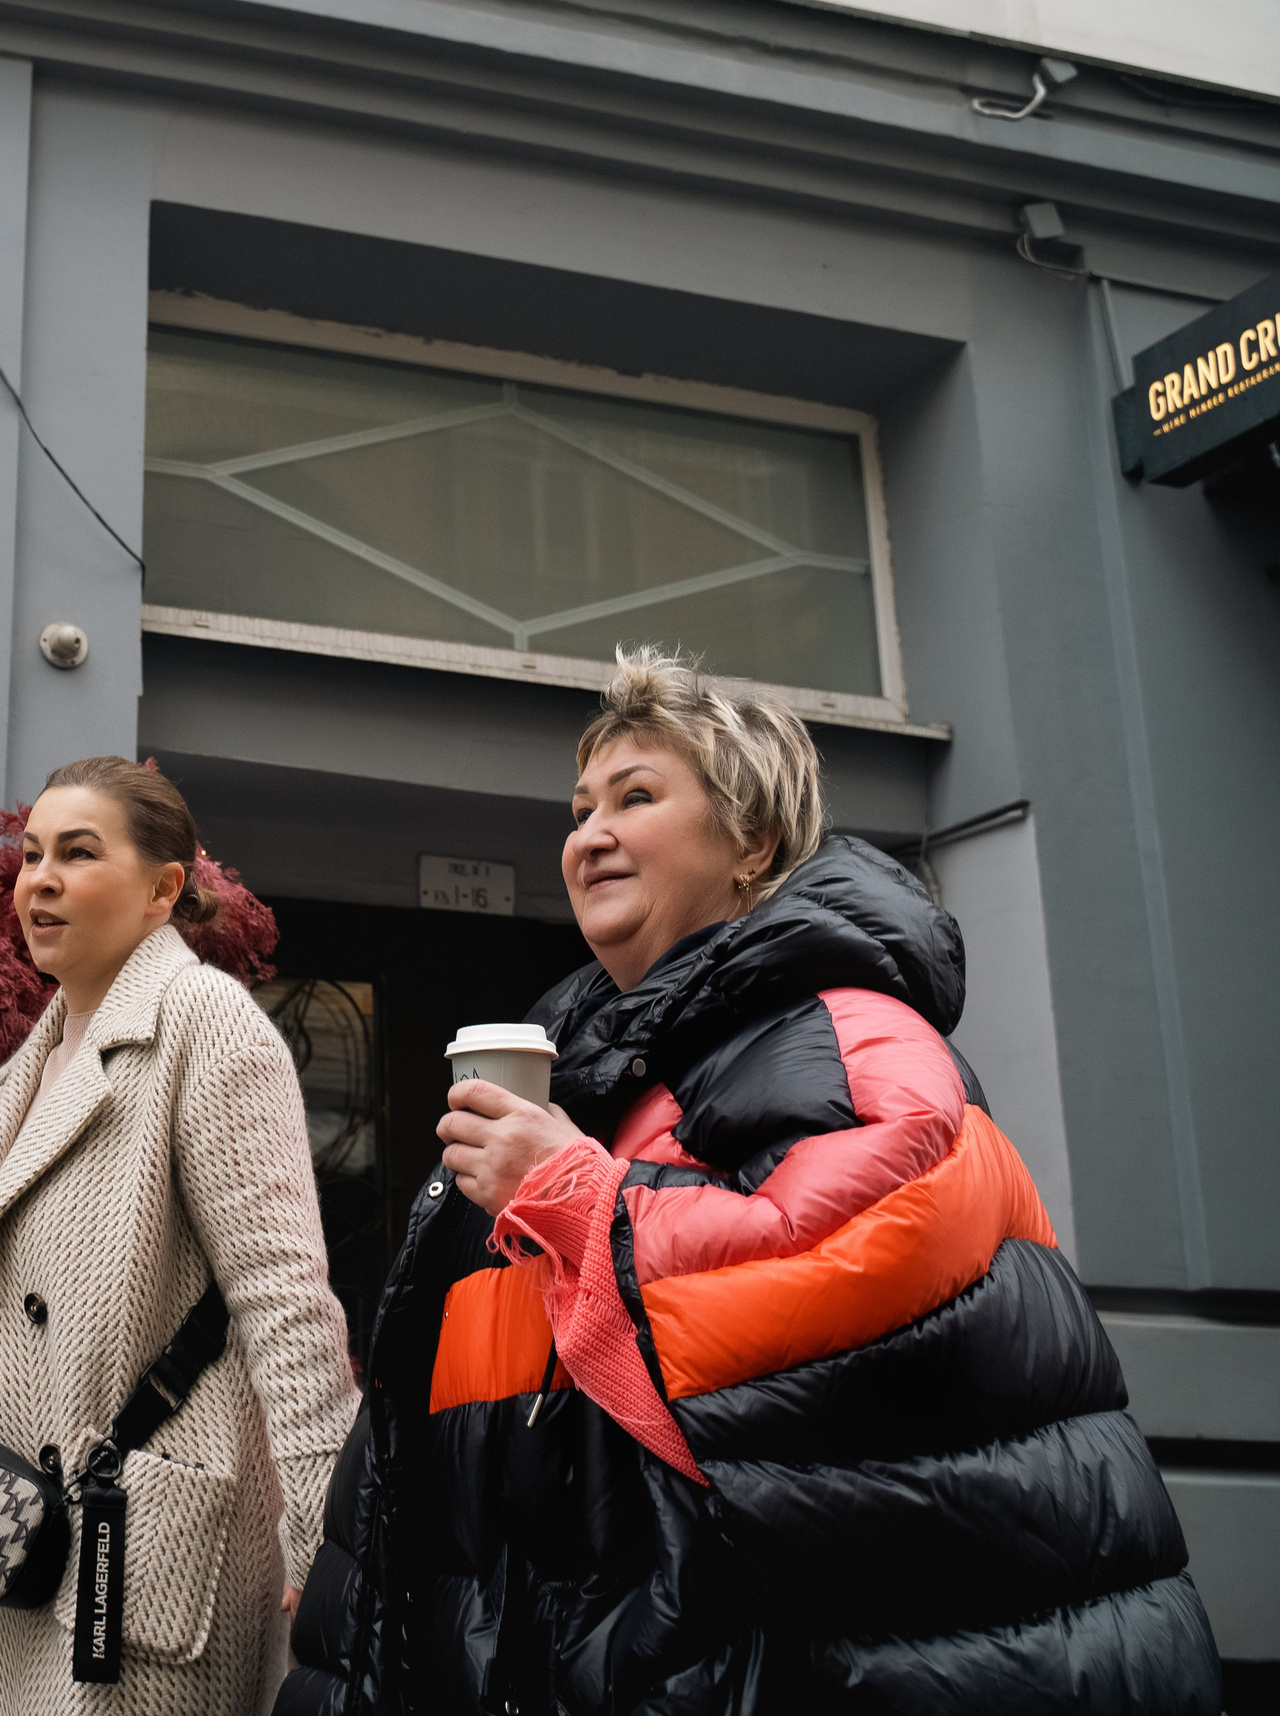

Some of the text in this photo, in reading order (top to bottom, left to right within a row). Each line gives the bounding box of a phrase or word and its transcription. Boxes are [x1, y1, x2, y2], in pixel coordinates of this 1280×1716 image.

[1148, 342, 1236, 421] GRAND
[1162, 413, 1187, 433] WINE
[92, 1521, 111, 1659] KARL LAGERFELD
